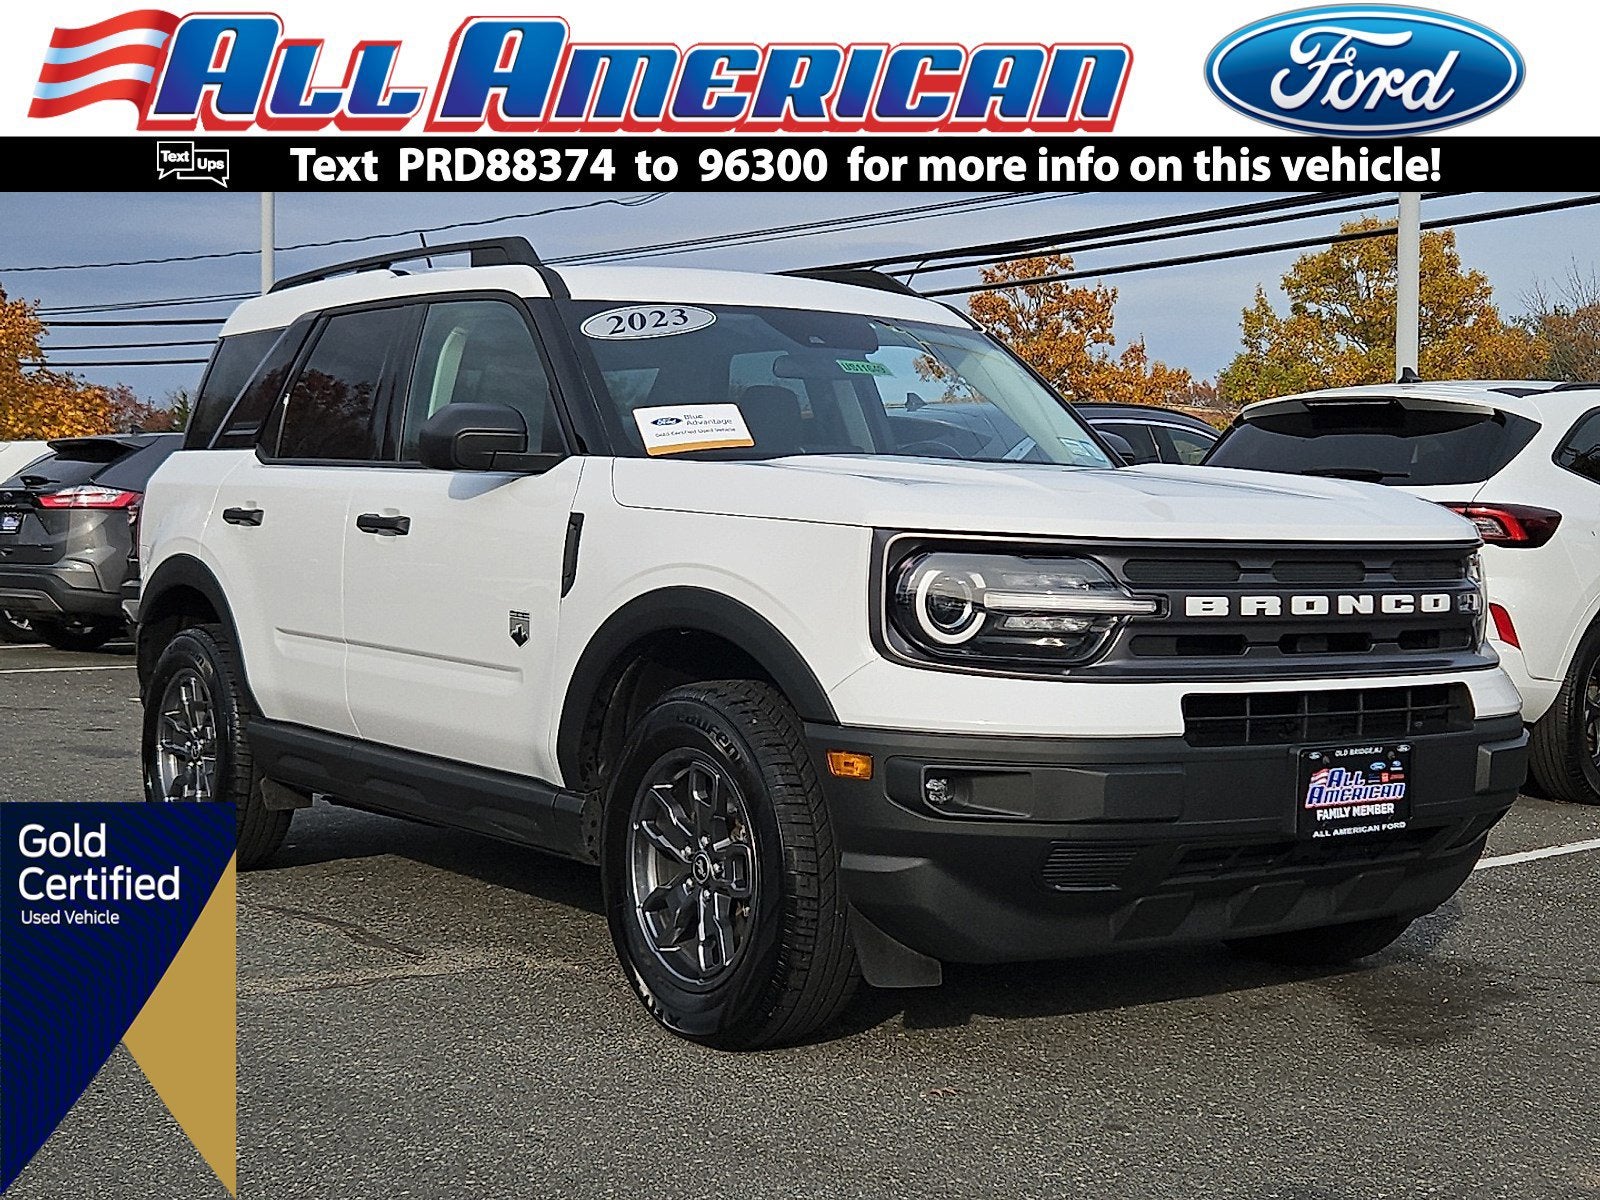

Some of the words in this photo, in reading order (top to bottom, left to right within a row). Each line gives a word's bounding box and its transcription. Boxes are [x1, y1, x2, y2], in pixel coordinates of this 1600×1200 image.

[606, 308, 688, 335] 2023
[1185, 593, 1451, 617] BRONCO
[1326, 767, 1366, 789] ALL
[1306, 782, 1406, 807] AMERICAN
[1316, 806, 1351, 821] FAMILY
[1312, 830, 1331, 839] ALL
[1332, 824, 1381, 836] AMERICAN
[1381, 821, 1406, 831] FORD
